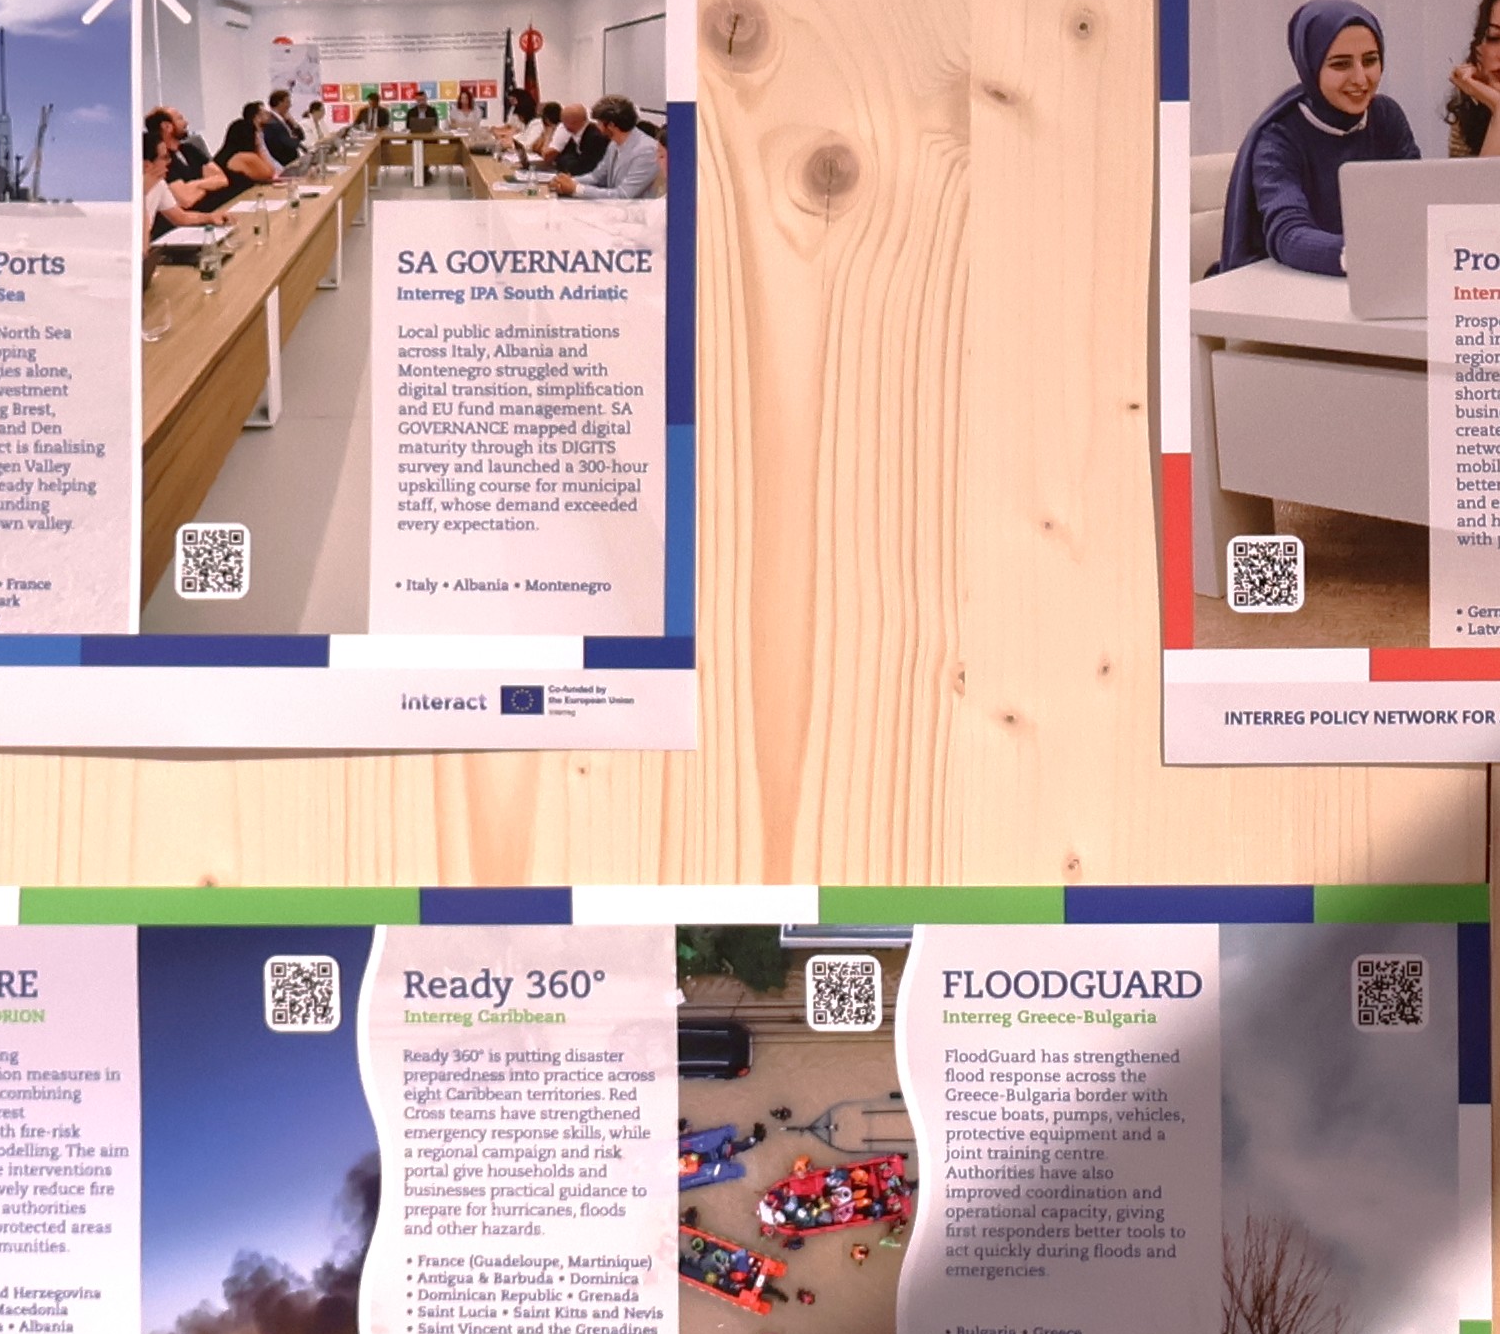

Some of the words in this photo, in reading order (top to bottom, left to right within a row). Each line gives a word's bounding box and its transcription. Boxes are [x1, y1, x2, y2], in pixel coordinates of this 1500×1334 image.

[397, 249, 438, 275] SA
[445, 247, 653, 275] GOVERNANCE
[1455, 530, 1494, 547] with
[401, 693, 487, 711] interact
[402, 967, 514, 1009] Ready
[526, 969, 605, 999] 360°
[941, 969, 1203, 999] FLOODGUARD
[942, 1009, 1013, 1029] Interreg
[1016, 1008, 1158, 1029] Greece-Bulgaria
[403, 1105, 446, 1120] Cross
[449, 1107, 496, 1121] teams
[499, 1105, 536, 1121] have
[539, 1105, 641, 1125] strengthened
